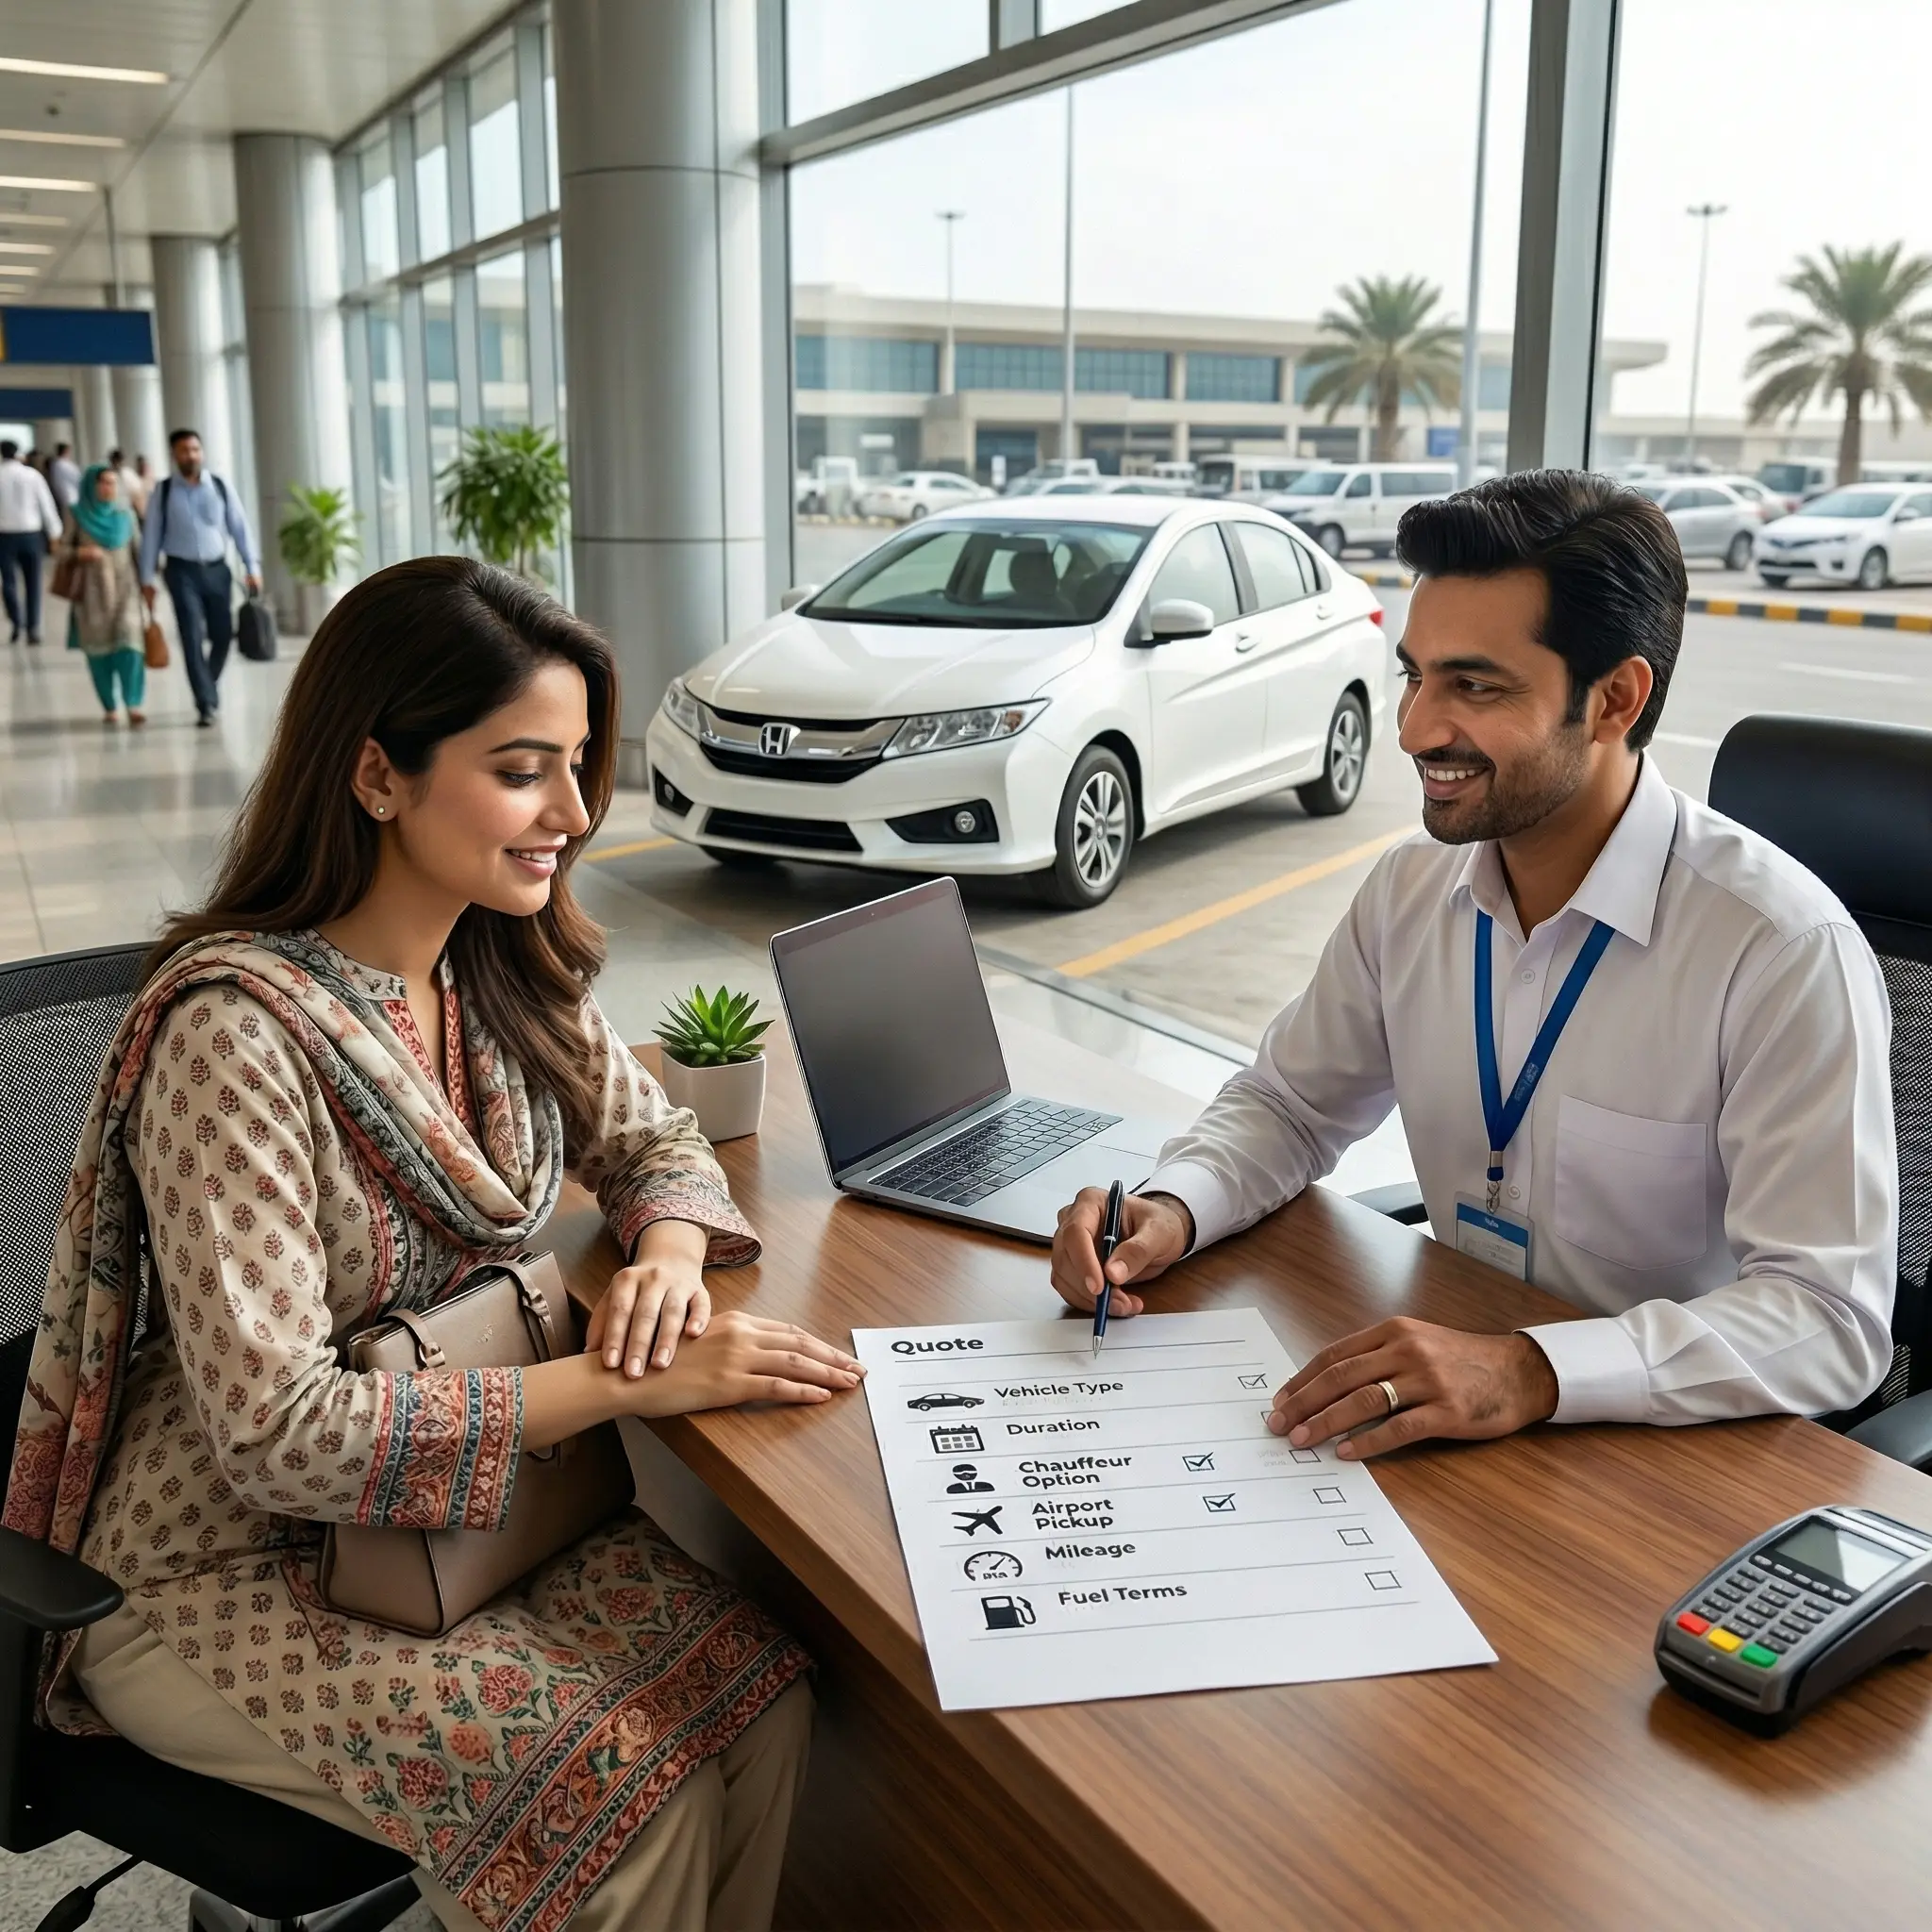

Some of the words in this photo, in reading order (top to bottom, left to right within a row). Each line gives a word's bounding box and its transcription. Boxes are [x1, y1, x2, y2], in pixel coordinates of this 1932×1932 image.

[891, 1338, 984, 1356] Quote
[993, 1384, 1070, 1398] Vehicle
[1073, 1381, 1124, 1395] Type
[1007, 1419, 1101, 1435] Duration
[1022, 1473, 1100, 1490] Option
[1032, 1499, 1114, 1517] Airport
[1035, 1516, 1113, 1530] Pickup
[1045, 1543, 1136, 1559] Mileage
[1058, 1589, 1109, 1606] Fuel
[1113, 1585, 1188, 1602] Terms
